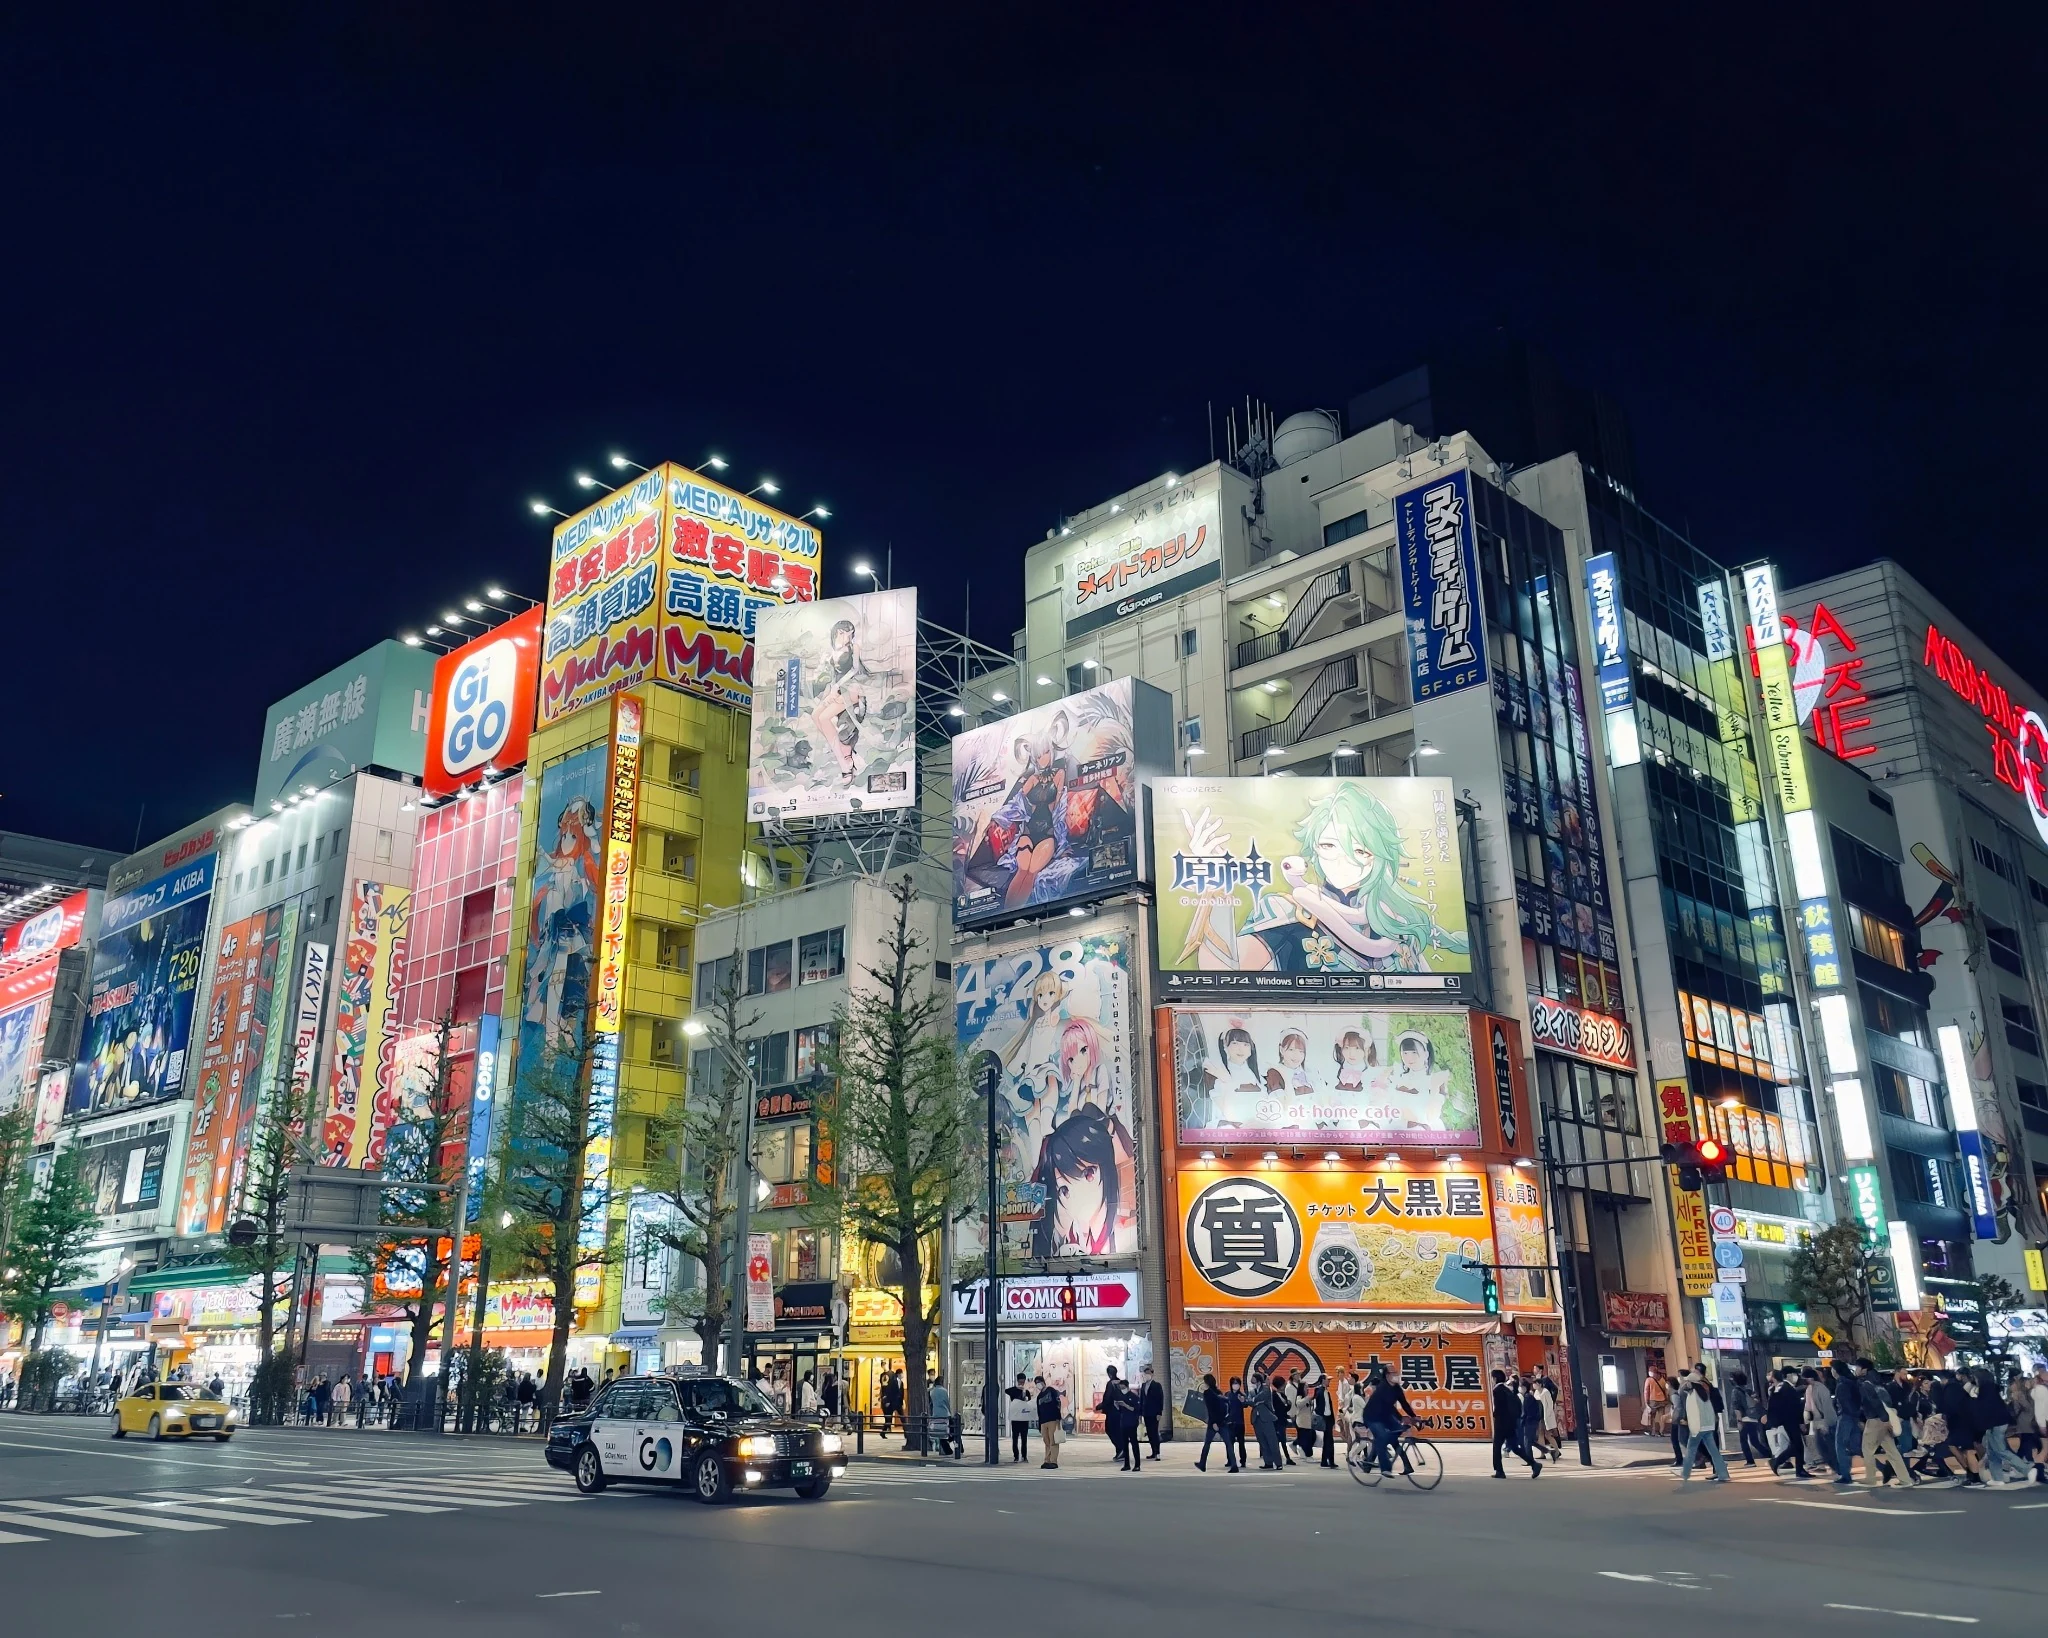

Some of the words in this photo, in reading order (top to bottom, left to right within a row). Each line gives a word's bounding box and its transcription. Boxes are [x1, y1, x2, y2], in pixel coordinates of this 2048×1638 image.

[1077, 525, 1207, 604] メイドカジノ
[1081, 755, 1123, 774] カーネリアン
[172, 868, 204, 897] AKIBA
[221, 934, 238, 958] 4F
[1183, 976, 1213, 985] PS5
[1220, 976, 1250, 985] PS4
[1256, 976, 1293, 986] Windows
[209, 1017, 225, 1042] 3F
[966, 1016, 980, 1026] FRI
[1533, 1003, 1631, 1061] メイドカジノ
[226, 1038, 247, 1120] Hey
[1365, 1104, 1401, 1119] cafe
[194, 1112, 210, 1137] 2F
[1363, 1178, 1484, 1217] 大黒屋
[1307, 1203, 1357, 1217] チケット
[1717, 1215, 1731, 1227] 40
[1691, 1206, 1710, 1257] FREE
[1006, 1311, 1057, 1320] Akihabara
[1382, 1333, 1450, 1350] チケット
